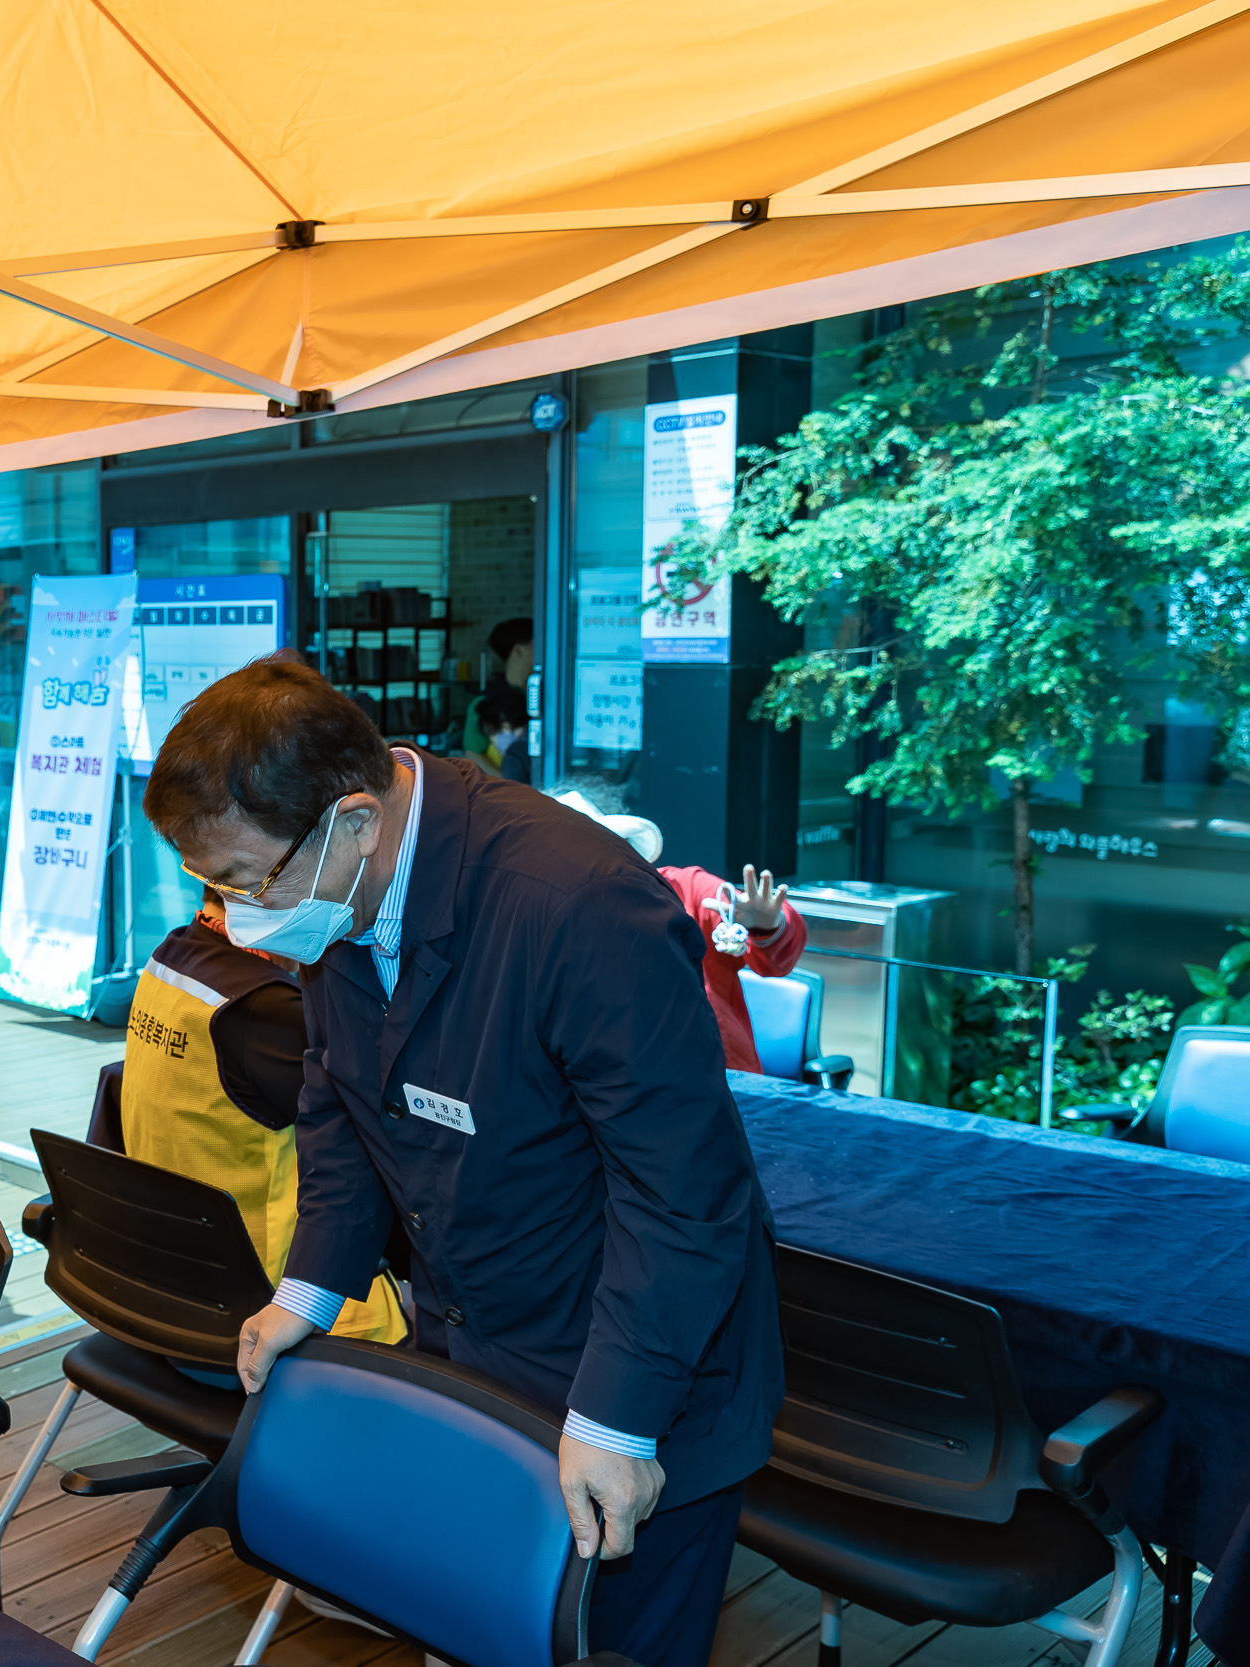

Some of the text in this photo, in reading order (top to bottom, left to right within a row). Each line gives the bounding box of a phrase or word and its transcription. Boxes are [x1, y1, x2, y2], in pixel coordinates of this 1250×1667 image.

[656, 611, 716, 627] 금연구역
[32, 755, 102, 776] 복지관 체험
[34, 845, 88, 869] 장바구니
